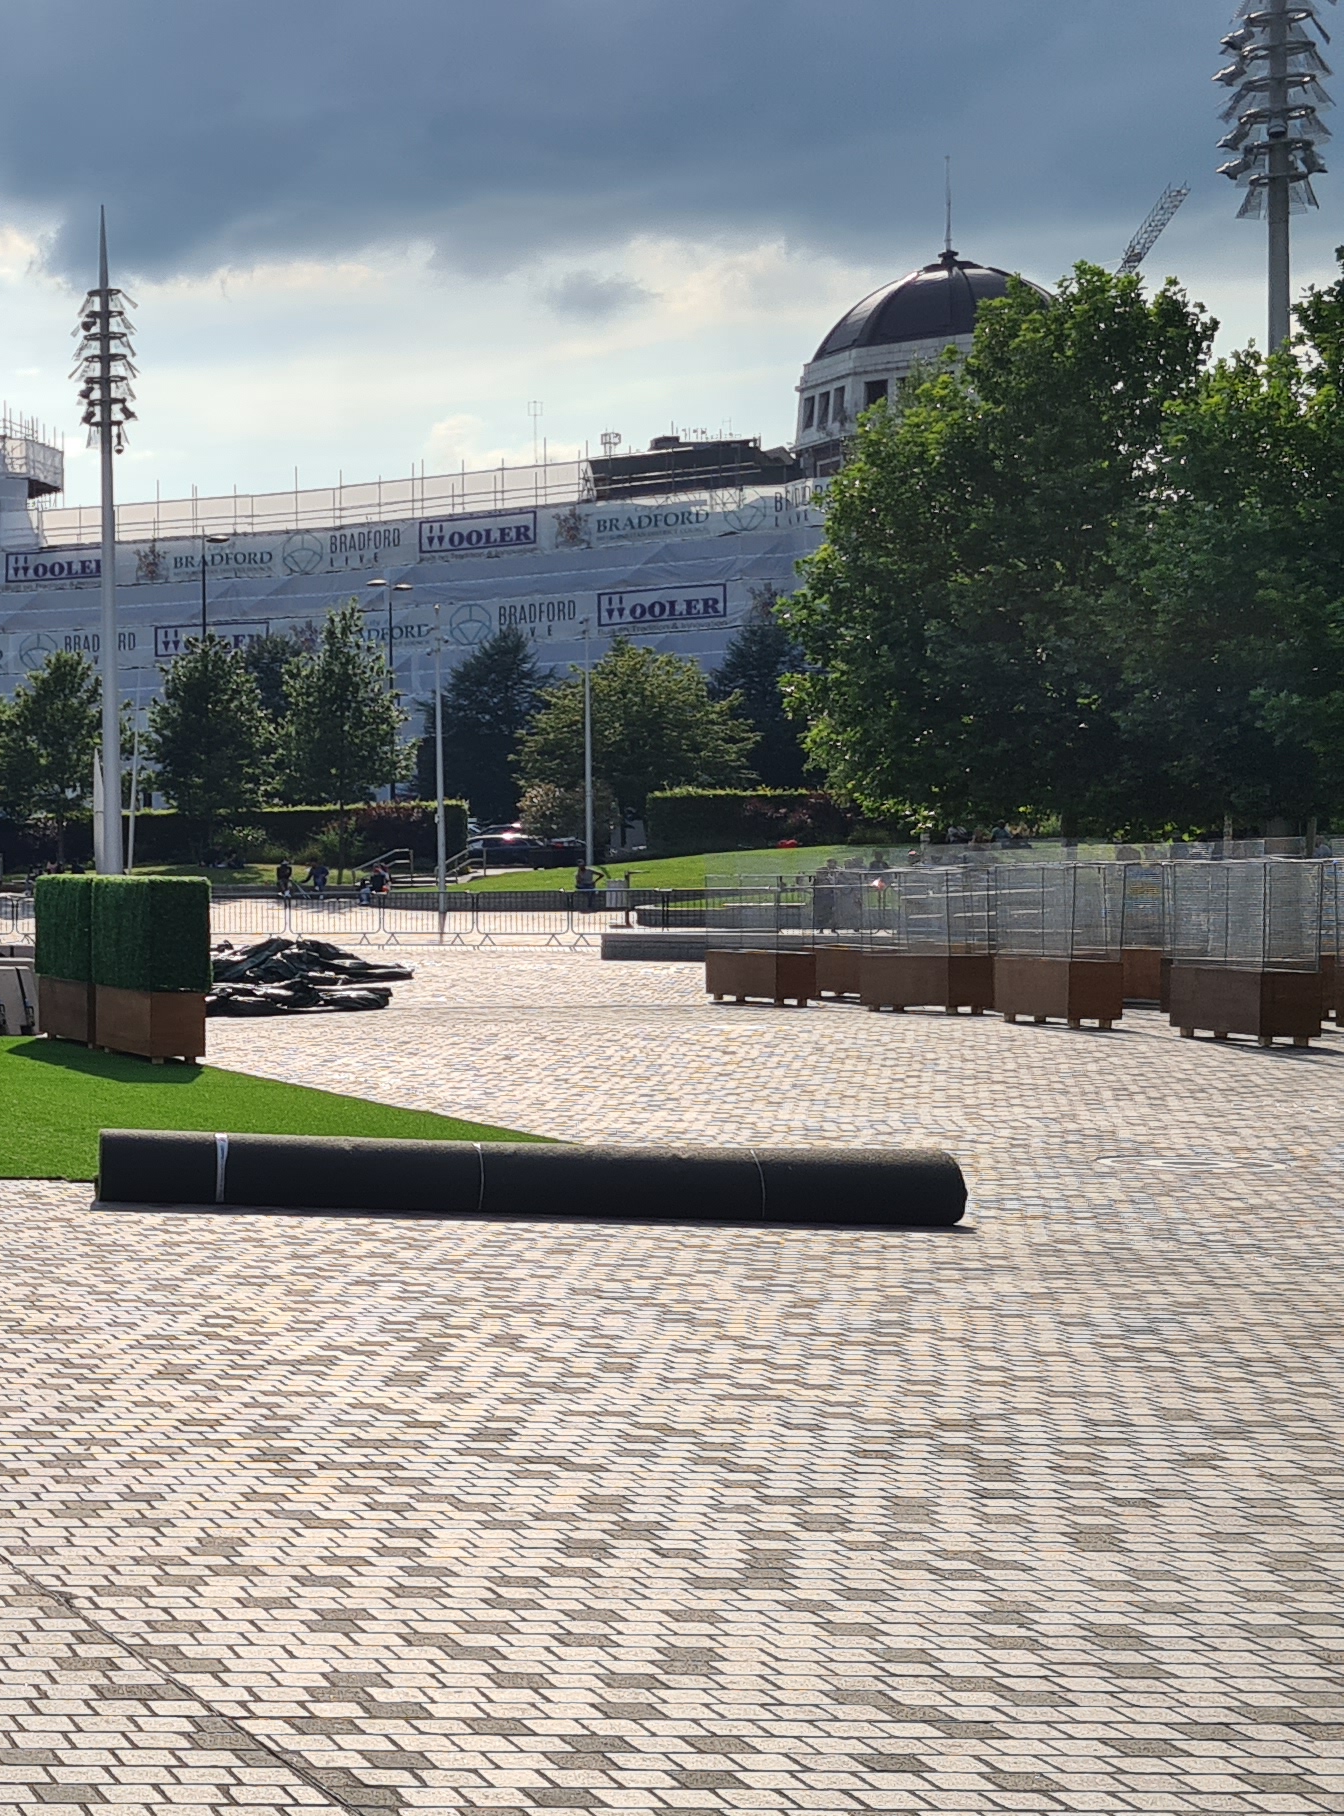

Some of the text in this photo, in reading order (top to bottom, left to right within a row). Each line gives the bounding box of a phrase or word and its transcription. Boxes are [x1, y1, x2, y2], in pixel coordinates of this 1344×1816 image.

[597, 510, 709, 533] BRADFORD
[330, 528, 400, 553] BRADFORD
[173, 551, 272, 569] BRADFORD
[498, 600, 576, 626] BRADFORD
[64, 632, 136, 653] BRADRD
[358, 624, 429, 642] DFORD
